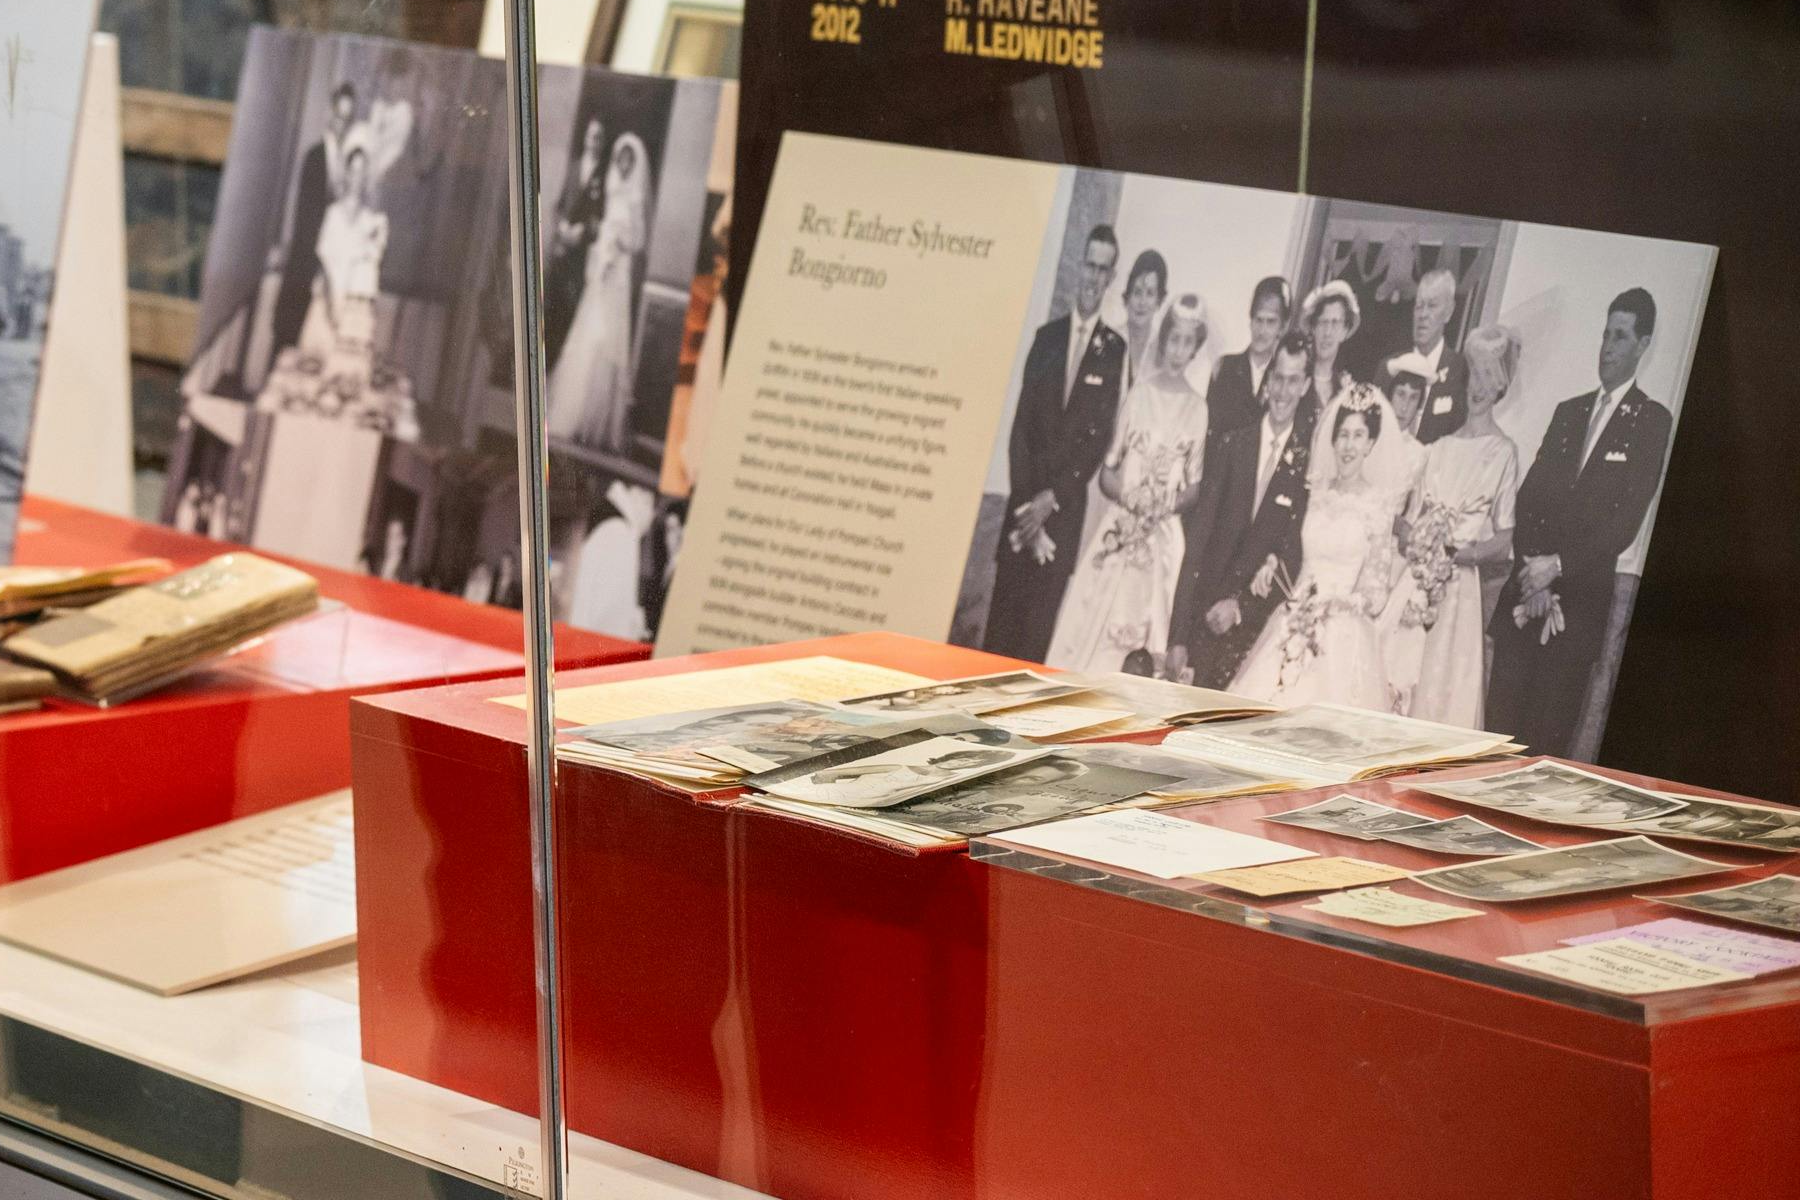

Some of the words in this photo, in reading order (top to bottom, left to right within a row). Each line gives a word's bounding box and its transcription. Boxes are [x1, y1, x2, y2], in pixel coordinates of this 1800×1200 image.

[811, 3, 861, 44] 2012
[944, 17, 973, 55] M.
[976, 24, 1103, 68] LEDWIDGE
[798, 202, 835, 236] Rev.
[841, 208, 905, 246] Father
[908, 218, 995, 259] Sylvester
[788, 246, 888, 290] Bongiorno
